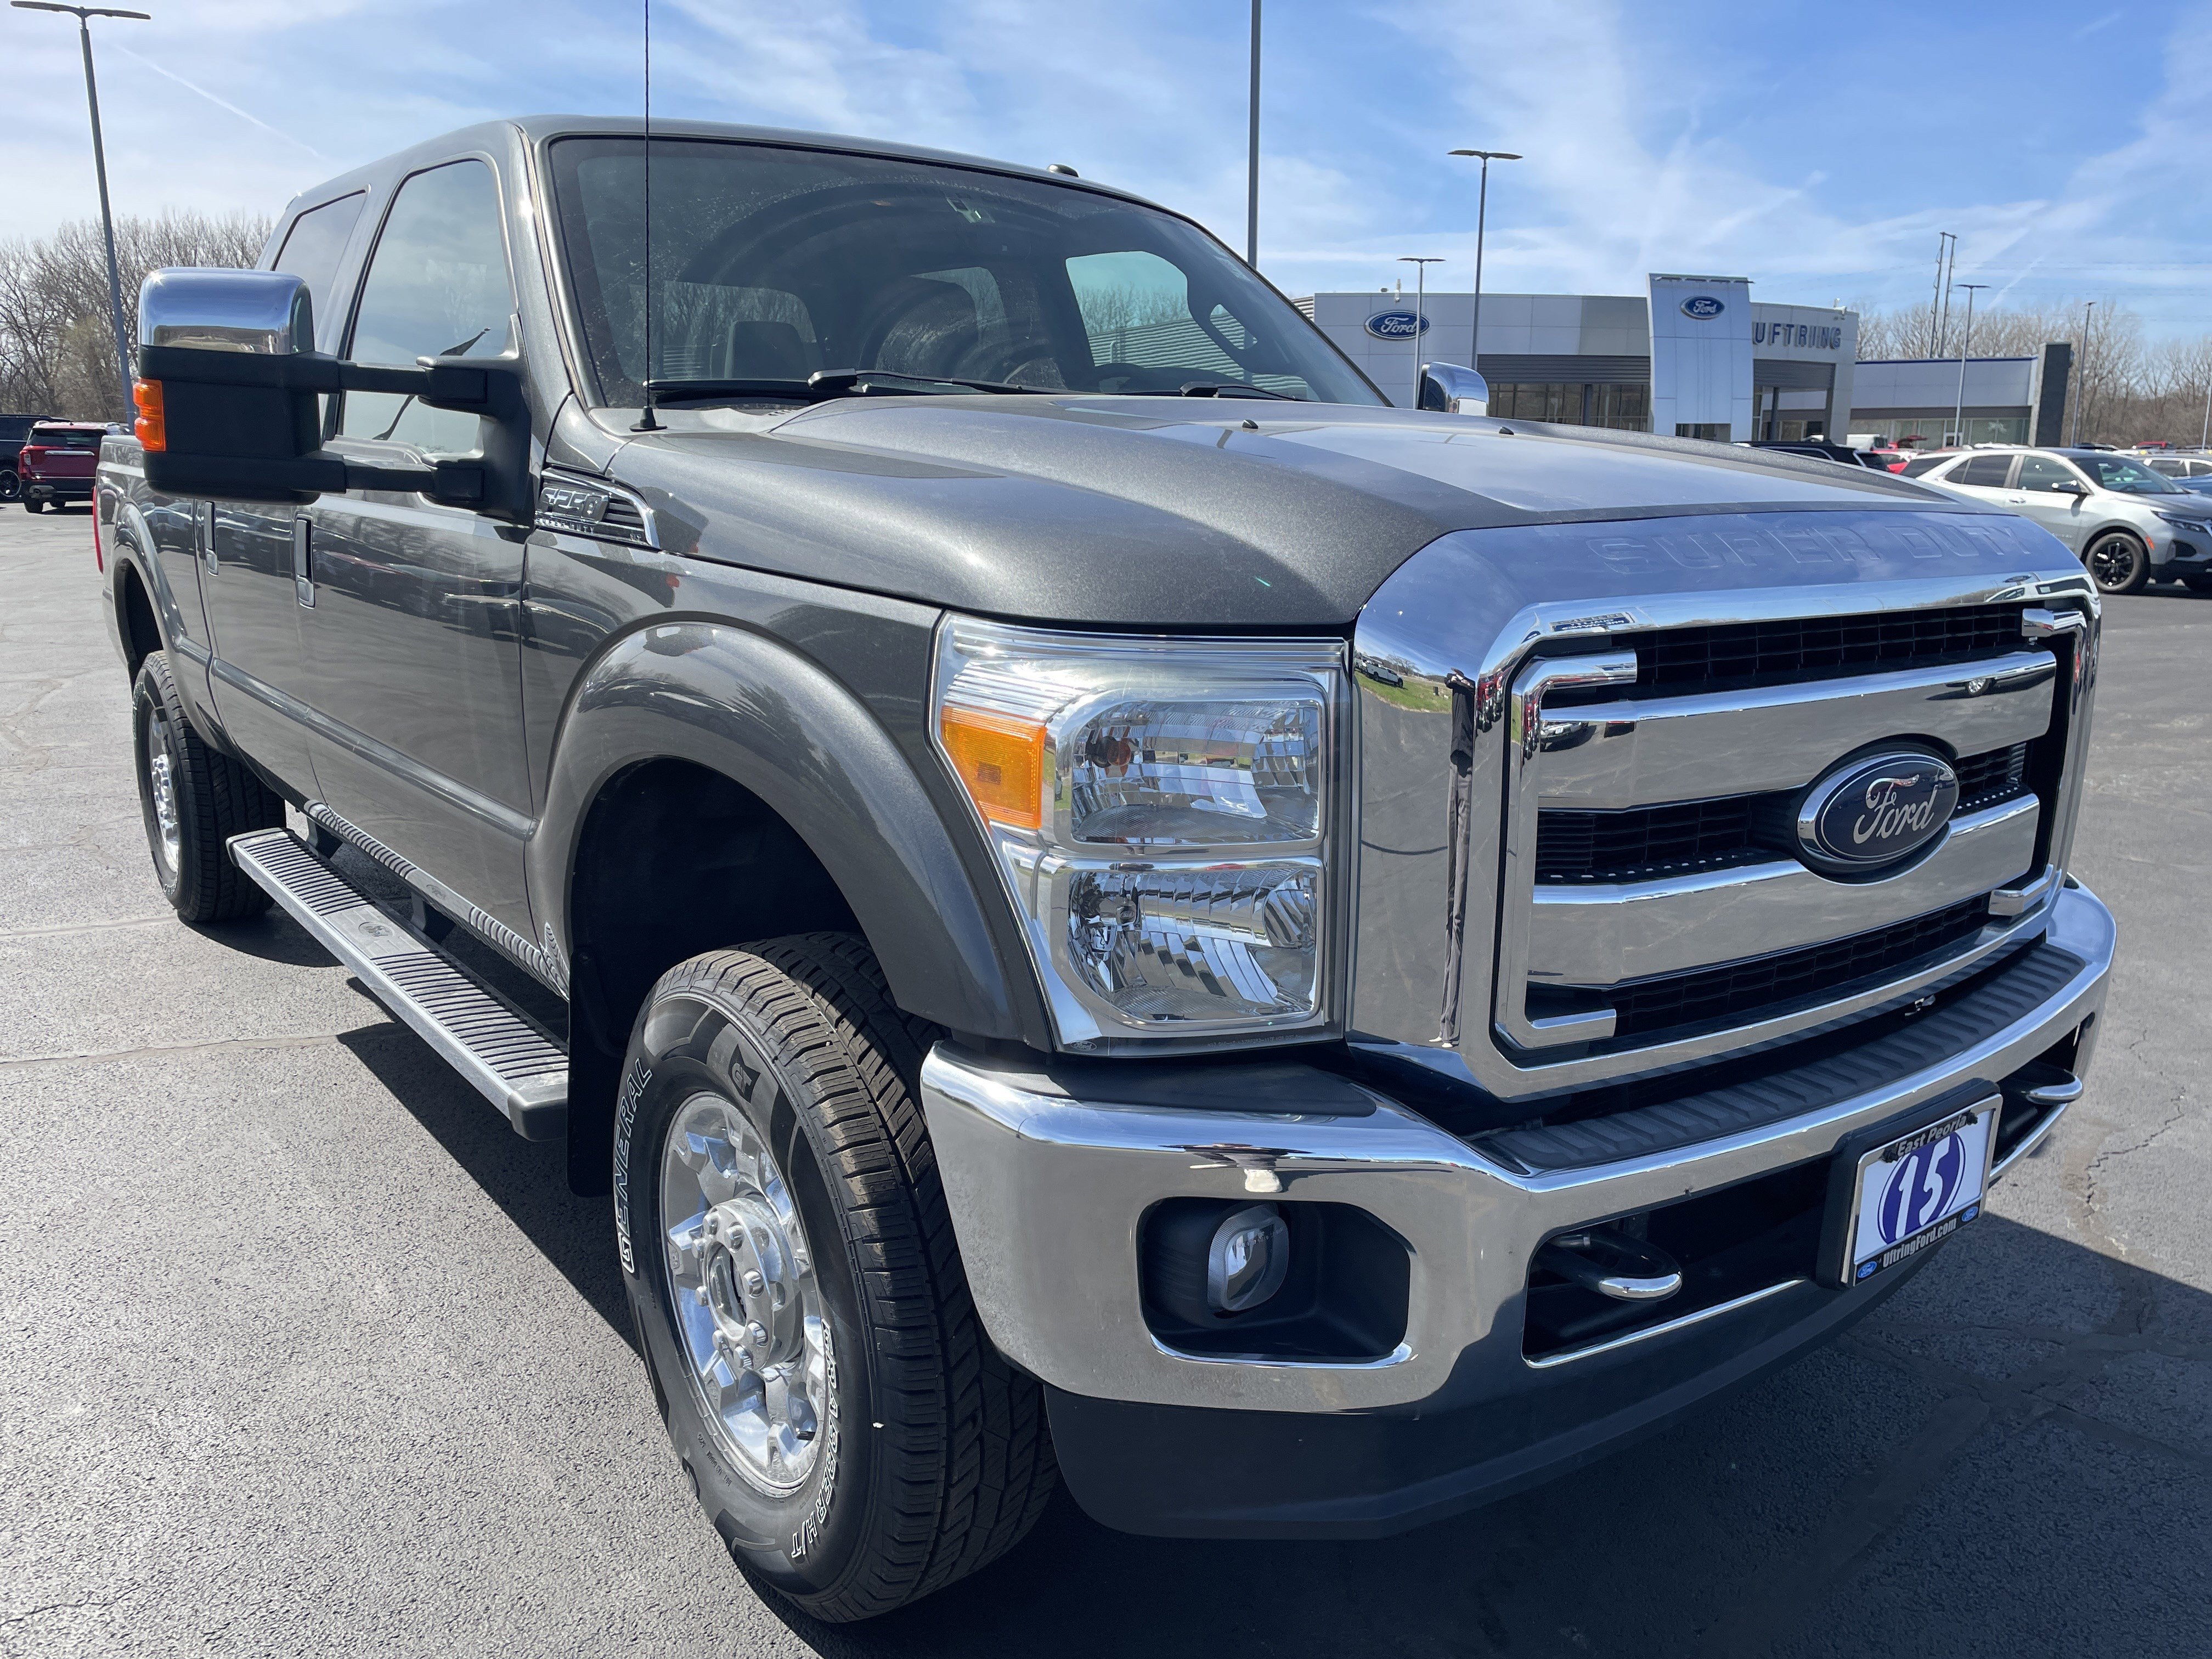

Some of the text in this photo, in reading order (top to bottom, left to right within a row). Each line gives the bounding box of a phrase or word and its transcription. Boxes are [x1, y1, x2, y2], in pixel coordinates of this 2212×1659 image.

[1381, 317, 1417, 333] Ford
[1693, 300, 1717, 313] Ford
[1754, 321, 1841, 348] UFTRING
[1585, 524, 2032, 574] SUPER DUTY
[1853, 774, 1938, 844] Ford
[1898, 1115, 1967, 1156] East Peoria
[614, 1058, 652, 1273] GENERAL
[1895, 1136, 1950, 1239] 15
[1883, 1218, 1957, 1268] UftringFord.com
[791, 1318, 839, 1558] GRABBER H/T
